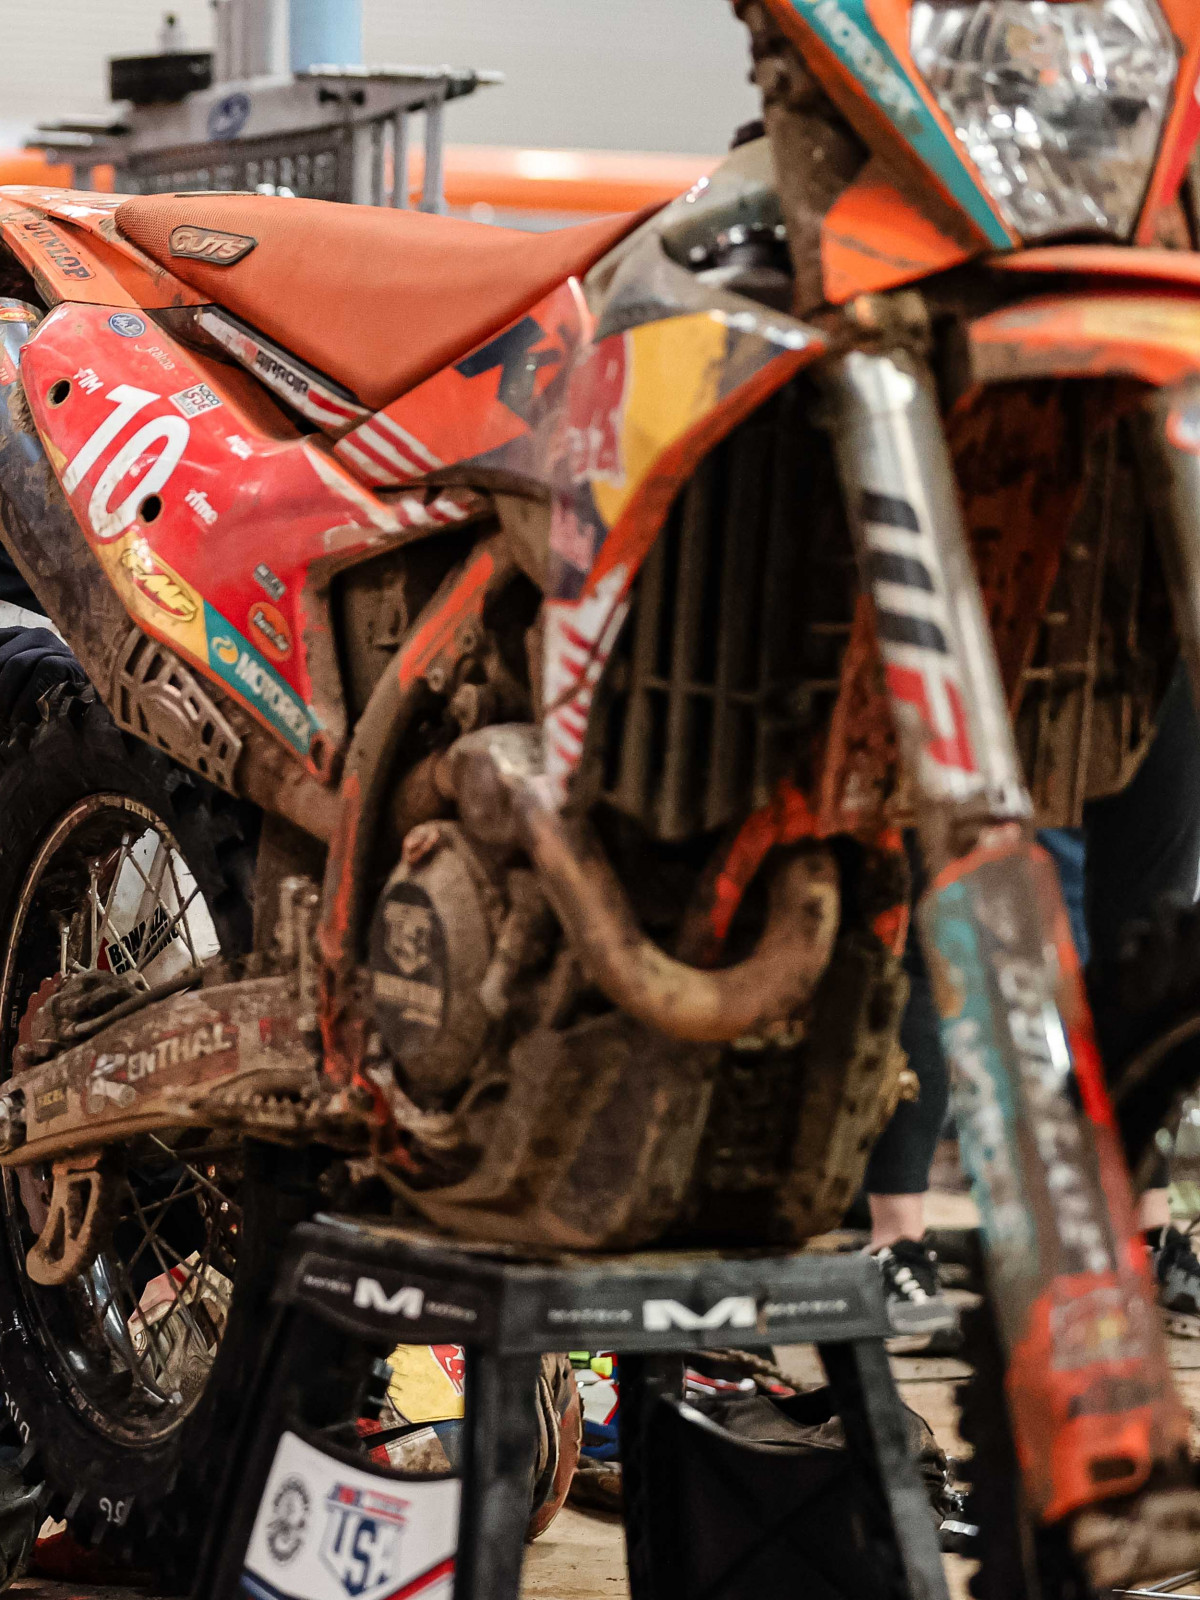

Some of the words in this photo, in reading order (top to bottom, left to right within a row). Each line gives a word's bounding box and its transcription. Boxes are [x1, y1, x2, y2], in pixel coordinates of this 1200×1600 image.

[173, 230, 247, 260] GUTS
[73, 368, 104, 395] FIM
[61, 384, 191, 538] 10
[353, 1277, 425, 1319] M
[642, 1296, 757, 1331] M
